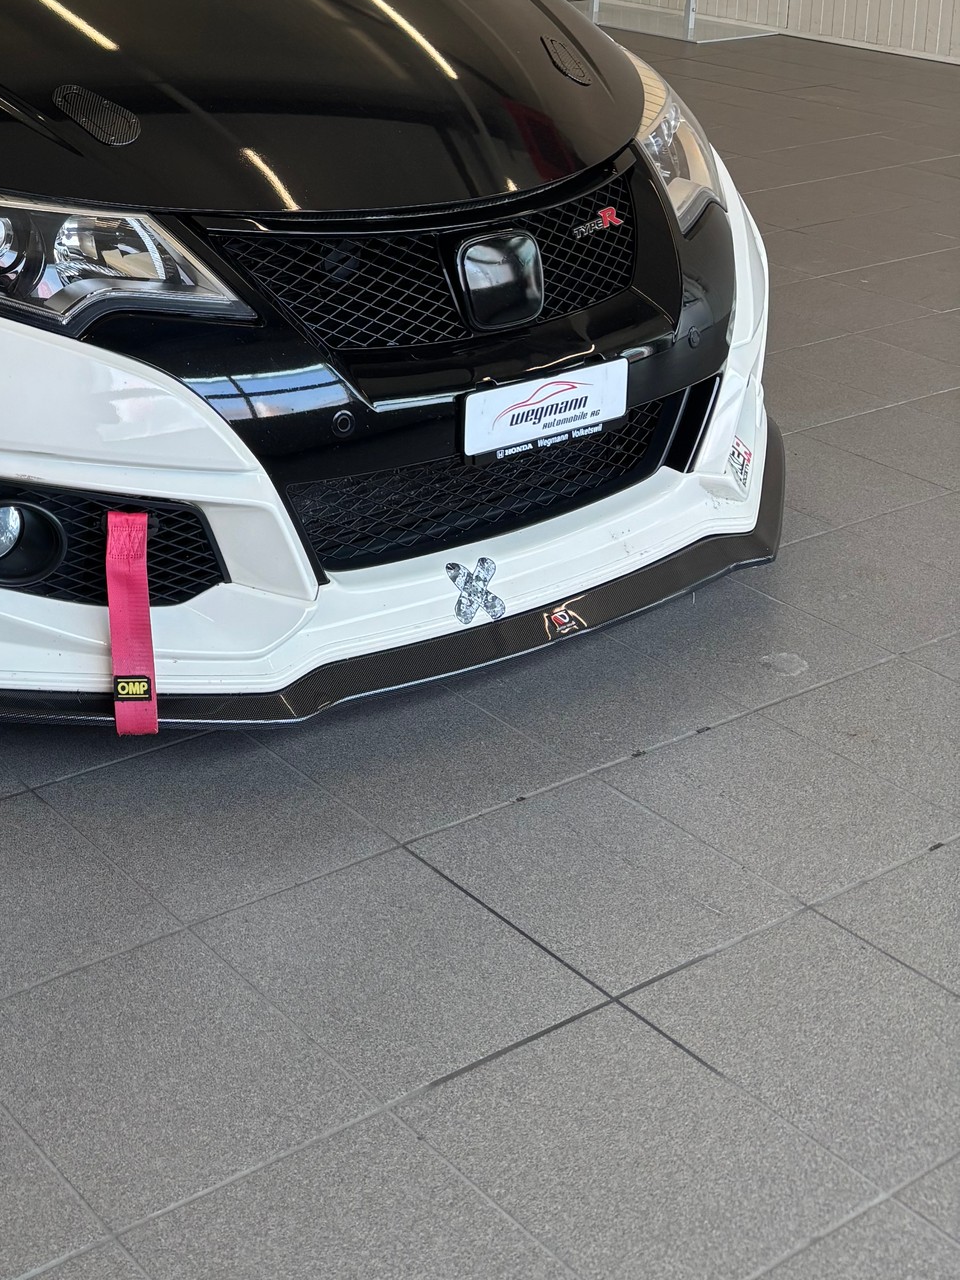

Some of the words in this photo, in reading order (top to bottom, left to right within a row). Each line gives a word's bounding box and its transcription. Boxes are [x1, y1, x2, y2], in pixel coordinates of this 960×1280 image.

[573, 219, 603, 238] TYPE
[597, 206, 624, 228] R
[509, 395, 589, 426] wegmann
[589, 409, 601, 418] AG
[504, 443, 534, 456] HONDA
[537, 433, 569, 448] Wegmann
[571, 423, 603, 438] Volketswil
[117, 681, 148, 695] OMP
